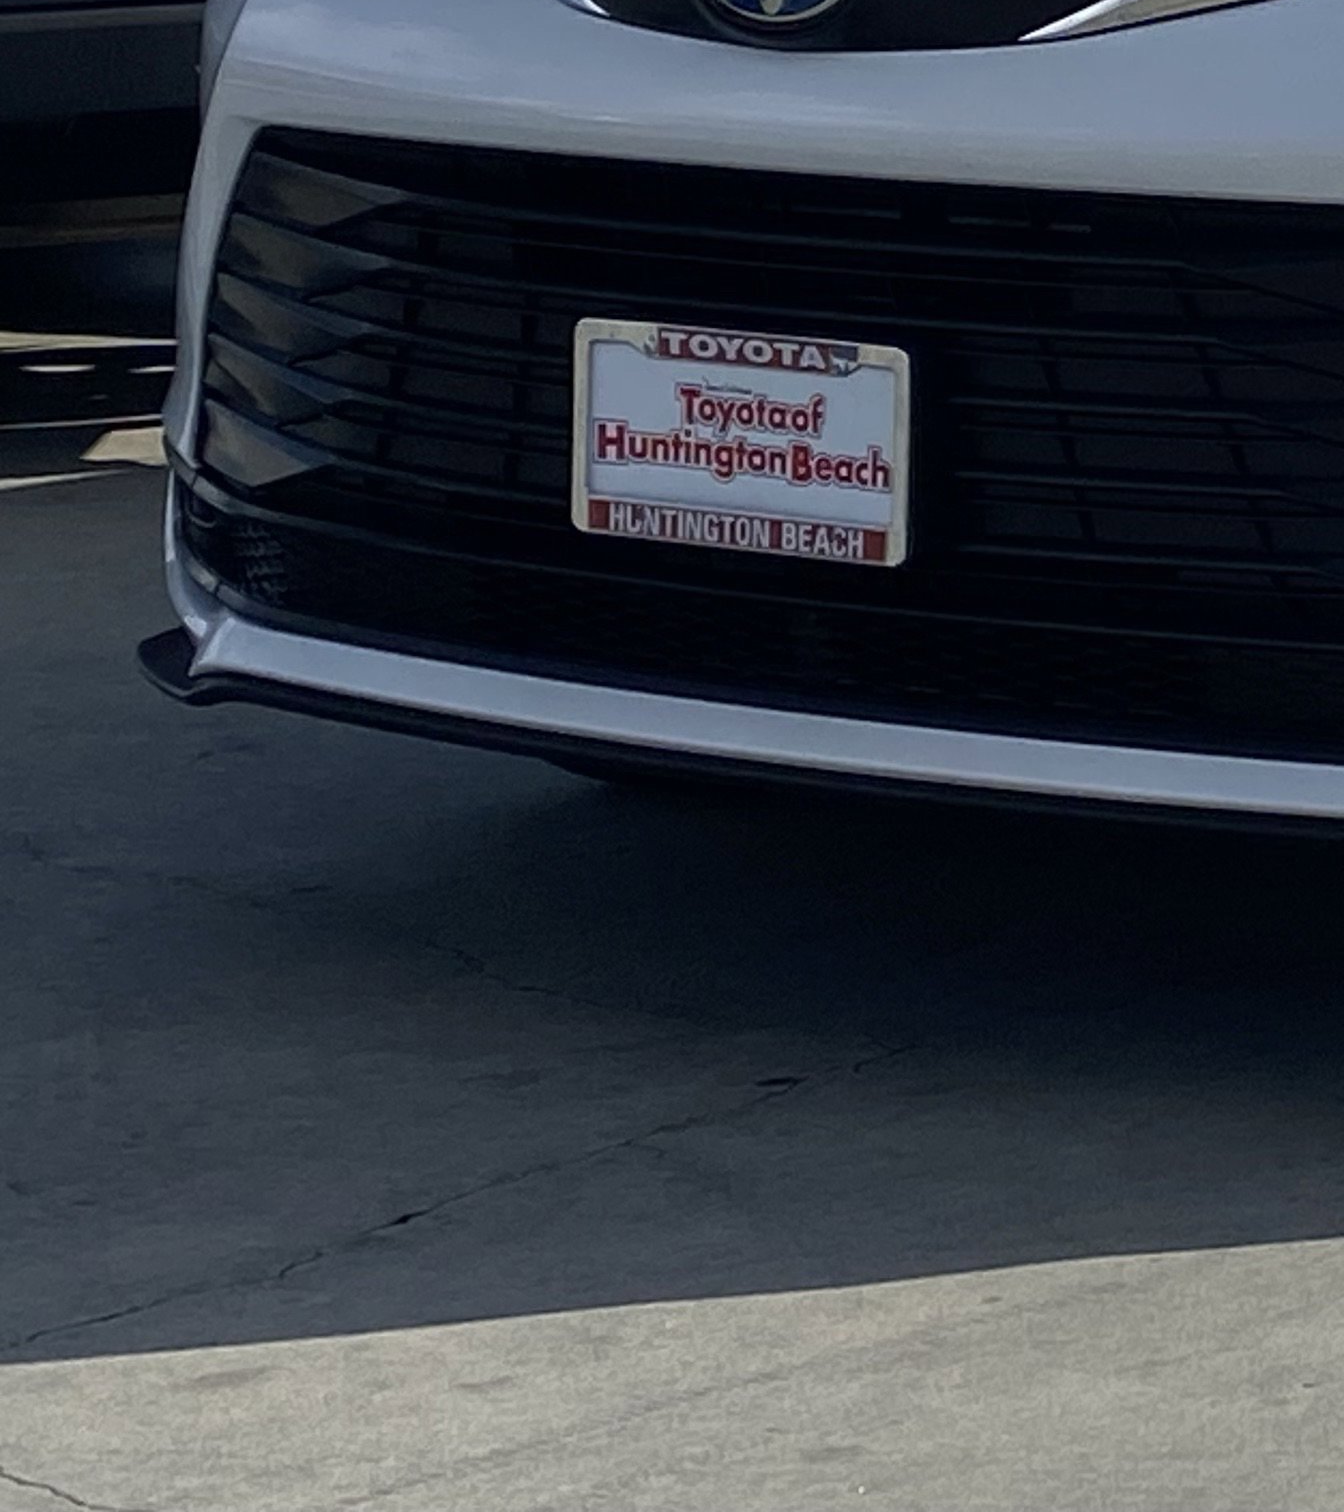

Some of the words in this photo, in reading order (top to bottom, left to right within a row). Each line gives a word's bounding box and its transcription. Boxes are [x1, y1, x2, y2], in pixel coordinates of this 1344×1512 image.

[660, 330, 826, 371] TOYOTA
[678, 386, 787, 434] Toyota
[788, 395, 826, 435] of
[596, 422, 787, 479] Huntington
[790, 442, 891, 488] Beach
[608, 501, 770, 549] HUNTINGTON
[780, 524, 866, 558] BEACH
